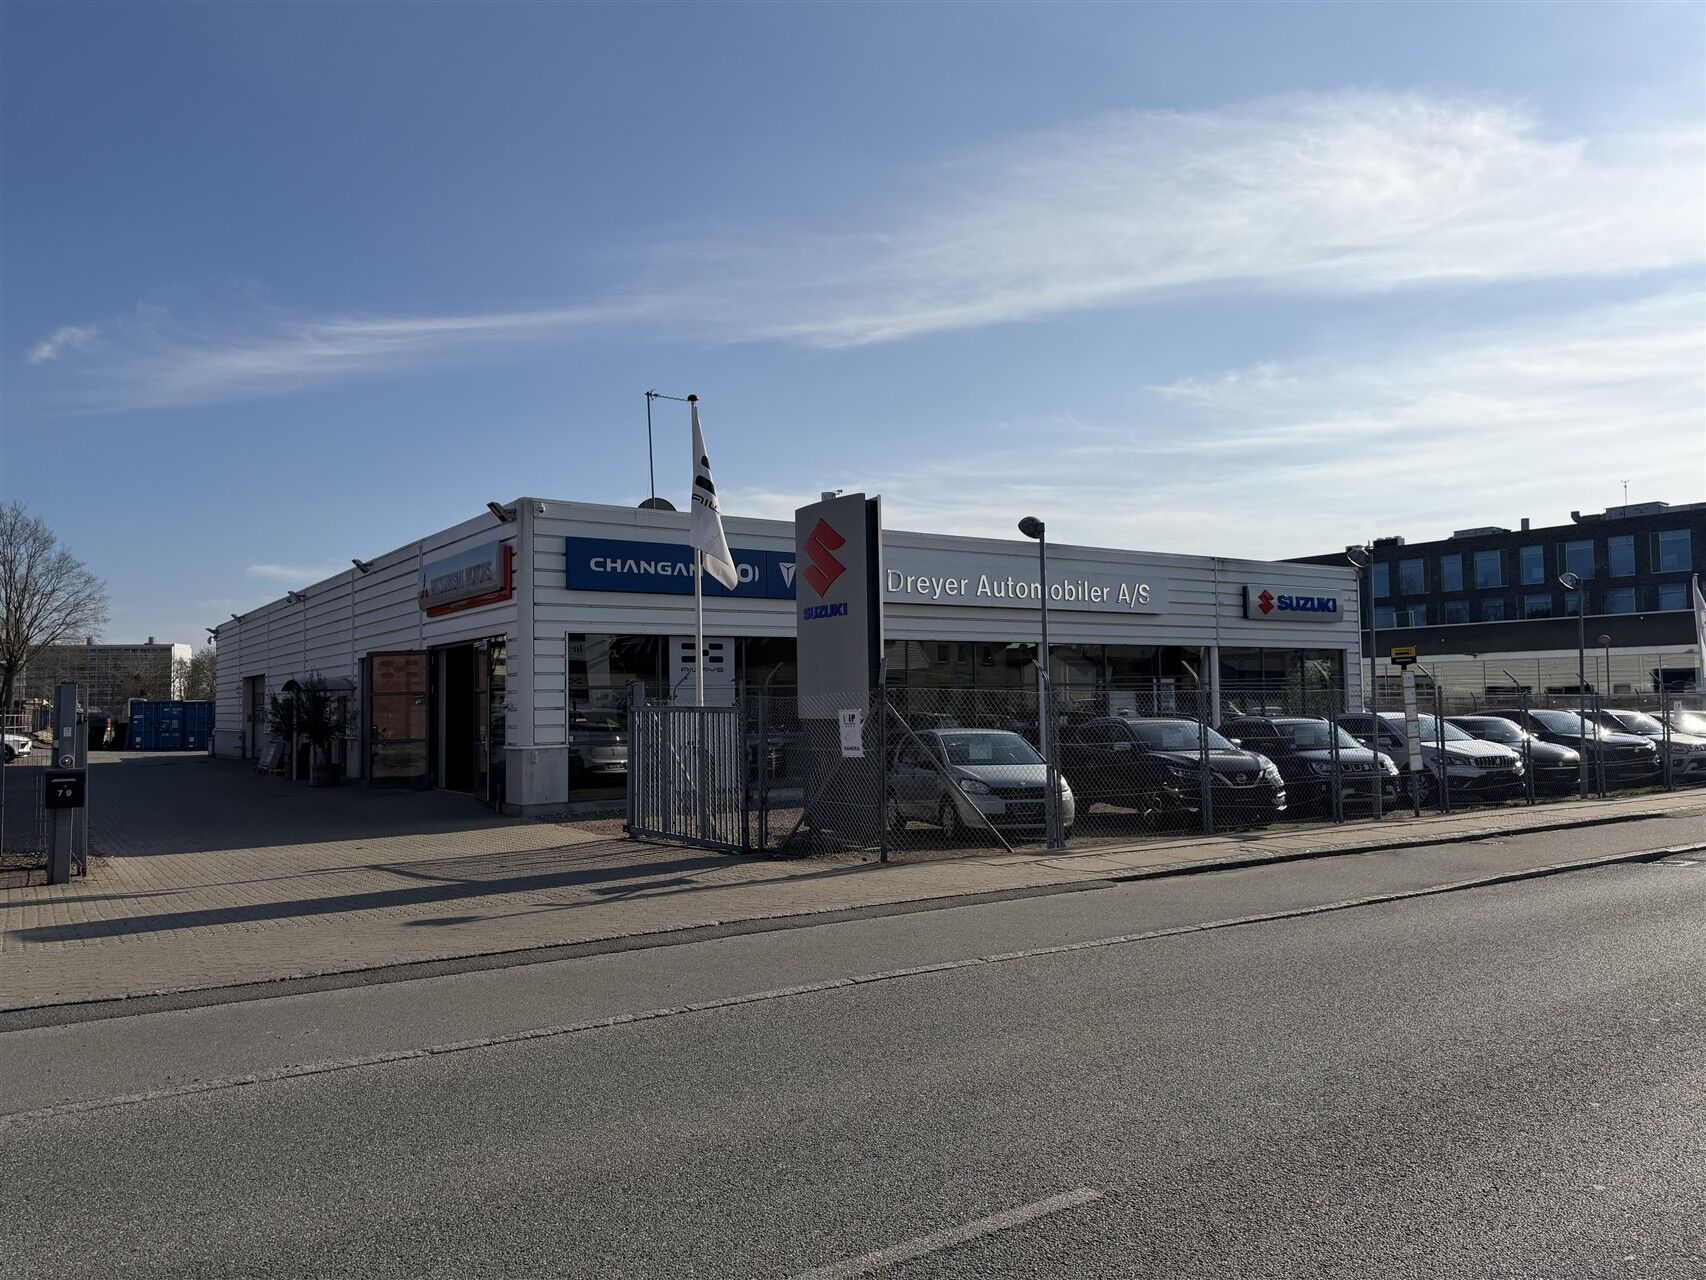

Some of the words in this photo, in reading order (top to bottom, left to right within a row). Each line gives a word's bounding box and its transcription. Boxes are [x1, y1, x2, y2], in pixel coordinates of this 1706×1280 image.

[589, 557, 703, 577] CHANGAN
[886, 569, 968, 600] Dreyer
[1118, 583, 1151, 608] A/S
[803, 602, 848, 621] SUZUKI
[1277, 594, 1337, 613] SUZUKI
